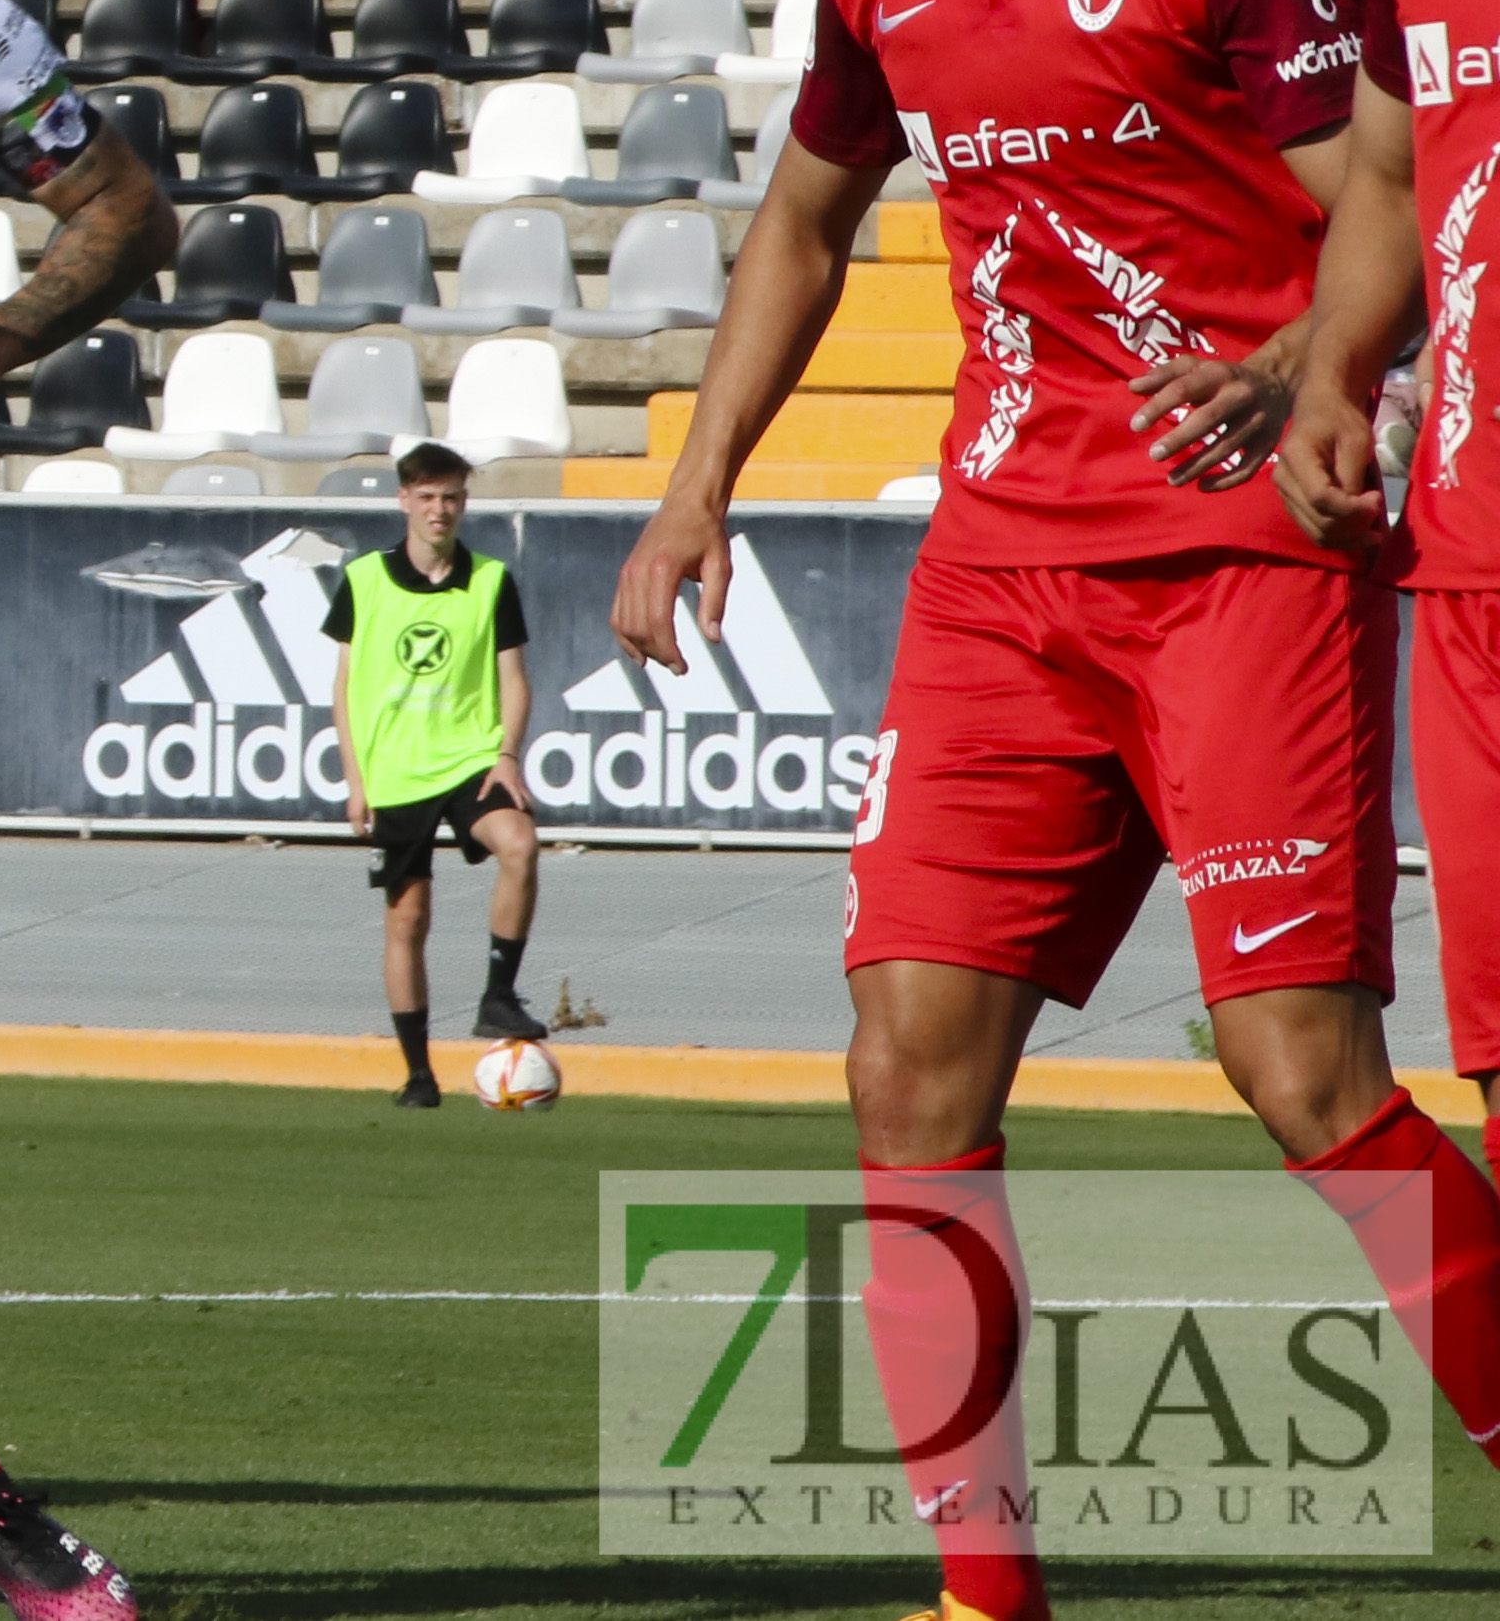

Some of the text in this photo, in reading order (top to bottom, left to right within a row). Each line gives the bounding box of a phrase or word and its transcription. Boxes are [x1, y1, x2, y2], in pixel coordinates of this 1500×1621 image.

[944, 116, 1072, 173] afar
[524, 710, 878, 812] adidas
[1205, 854, 1285, 888] PLAZA
